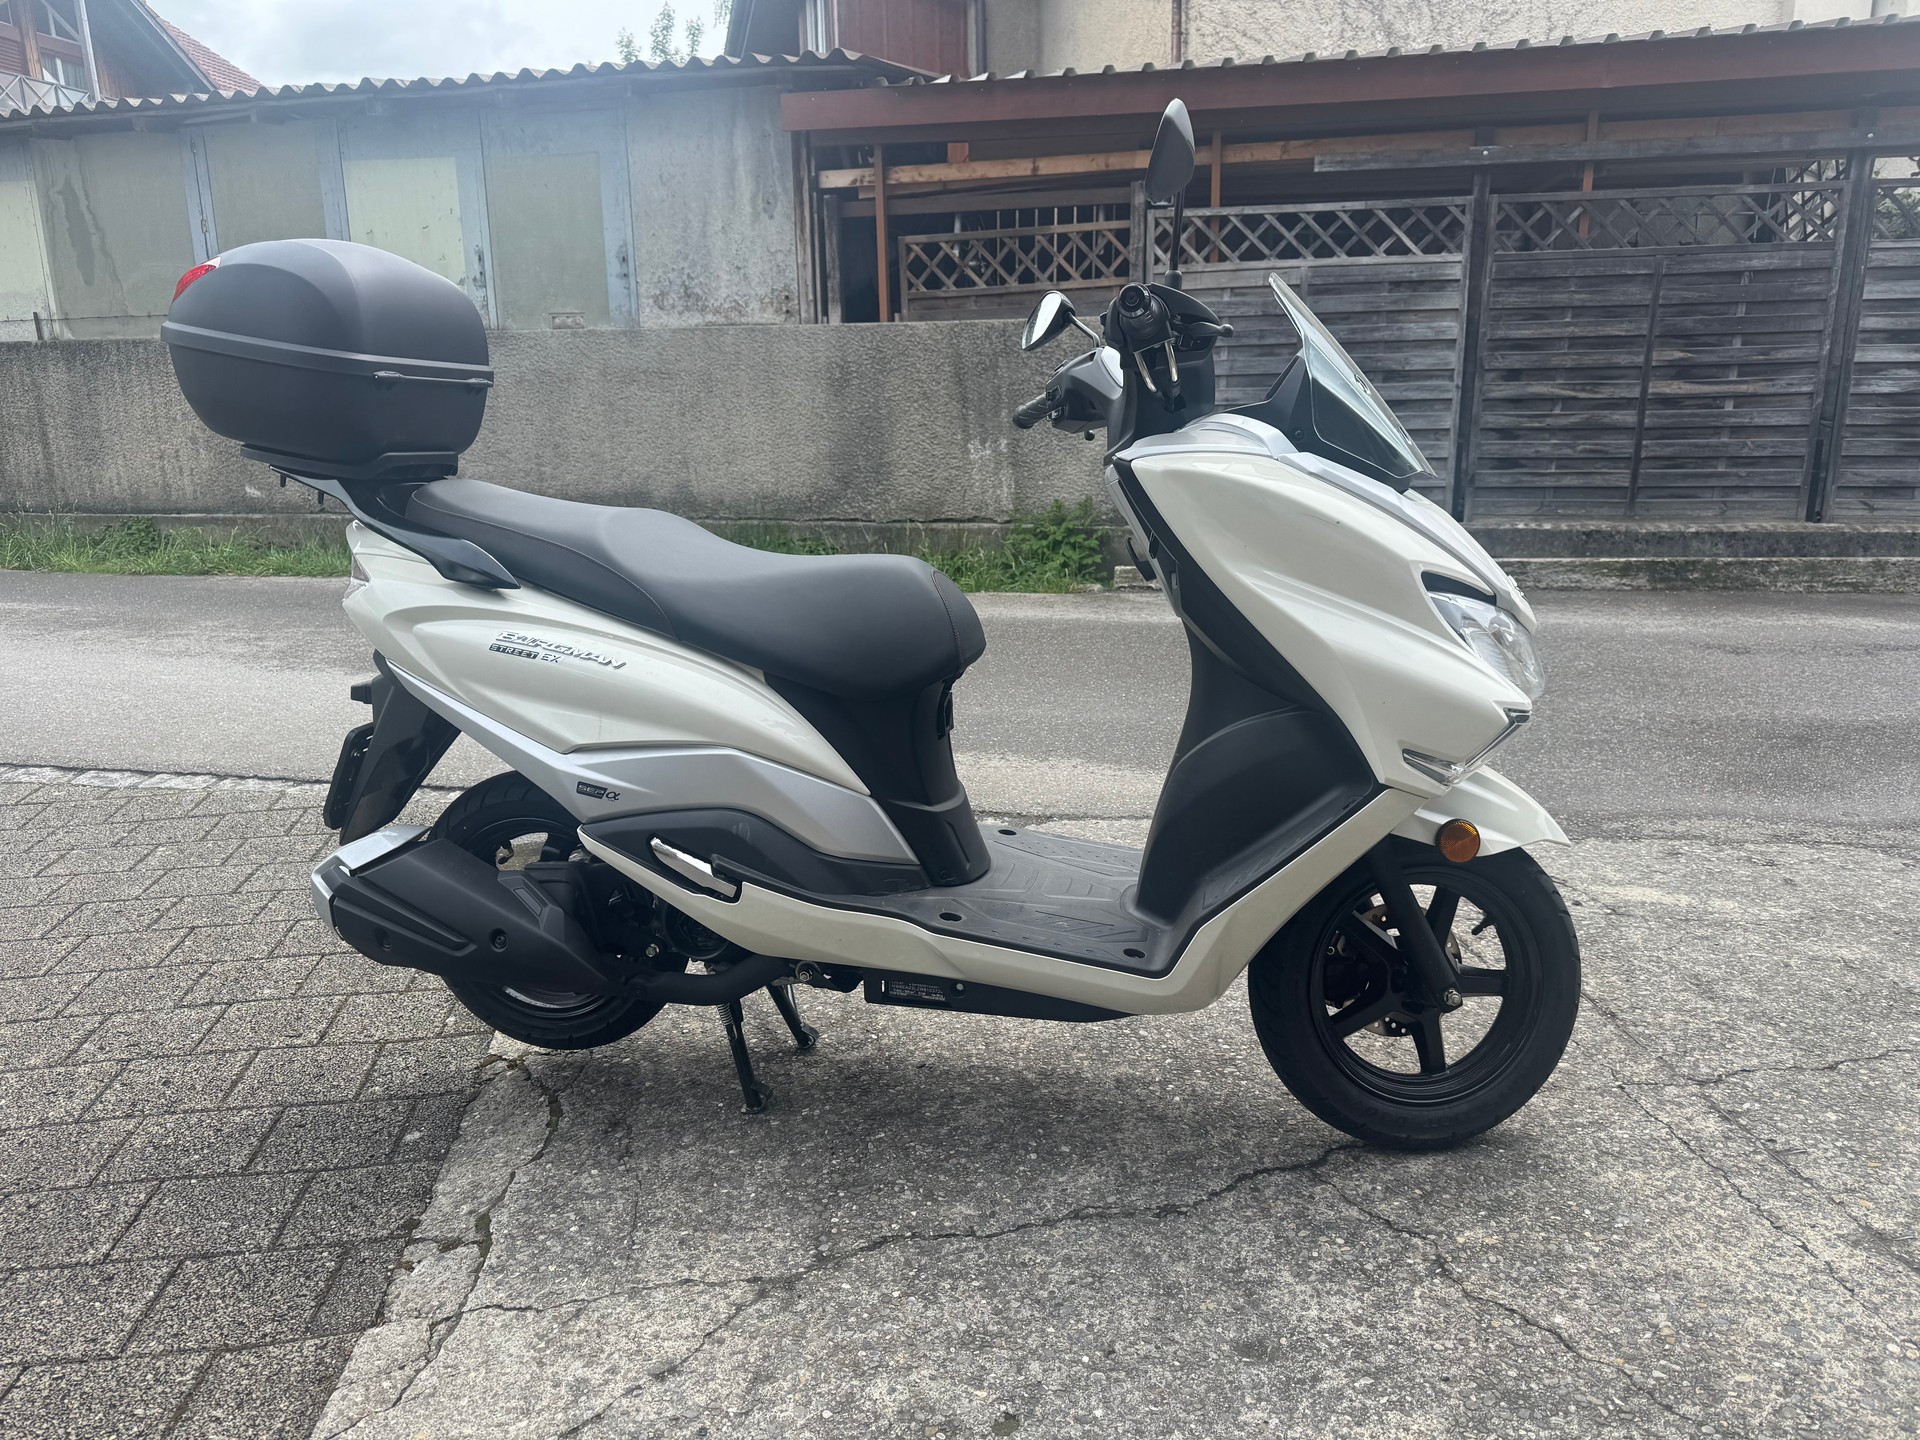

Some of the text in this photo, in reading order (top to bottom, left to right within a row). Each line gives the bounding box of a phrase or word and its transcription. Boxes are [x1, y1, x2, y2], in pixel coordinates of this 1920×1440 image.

[490, 643, 562, 663] STREET EX
[496, 631, 627, 669] BURGMAN
